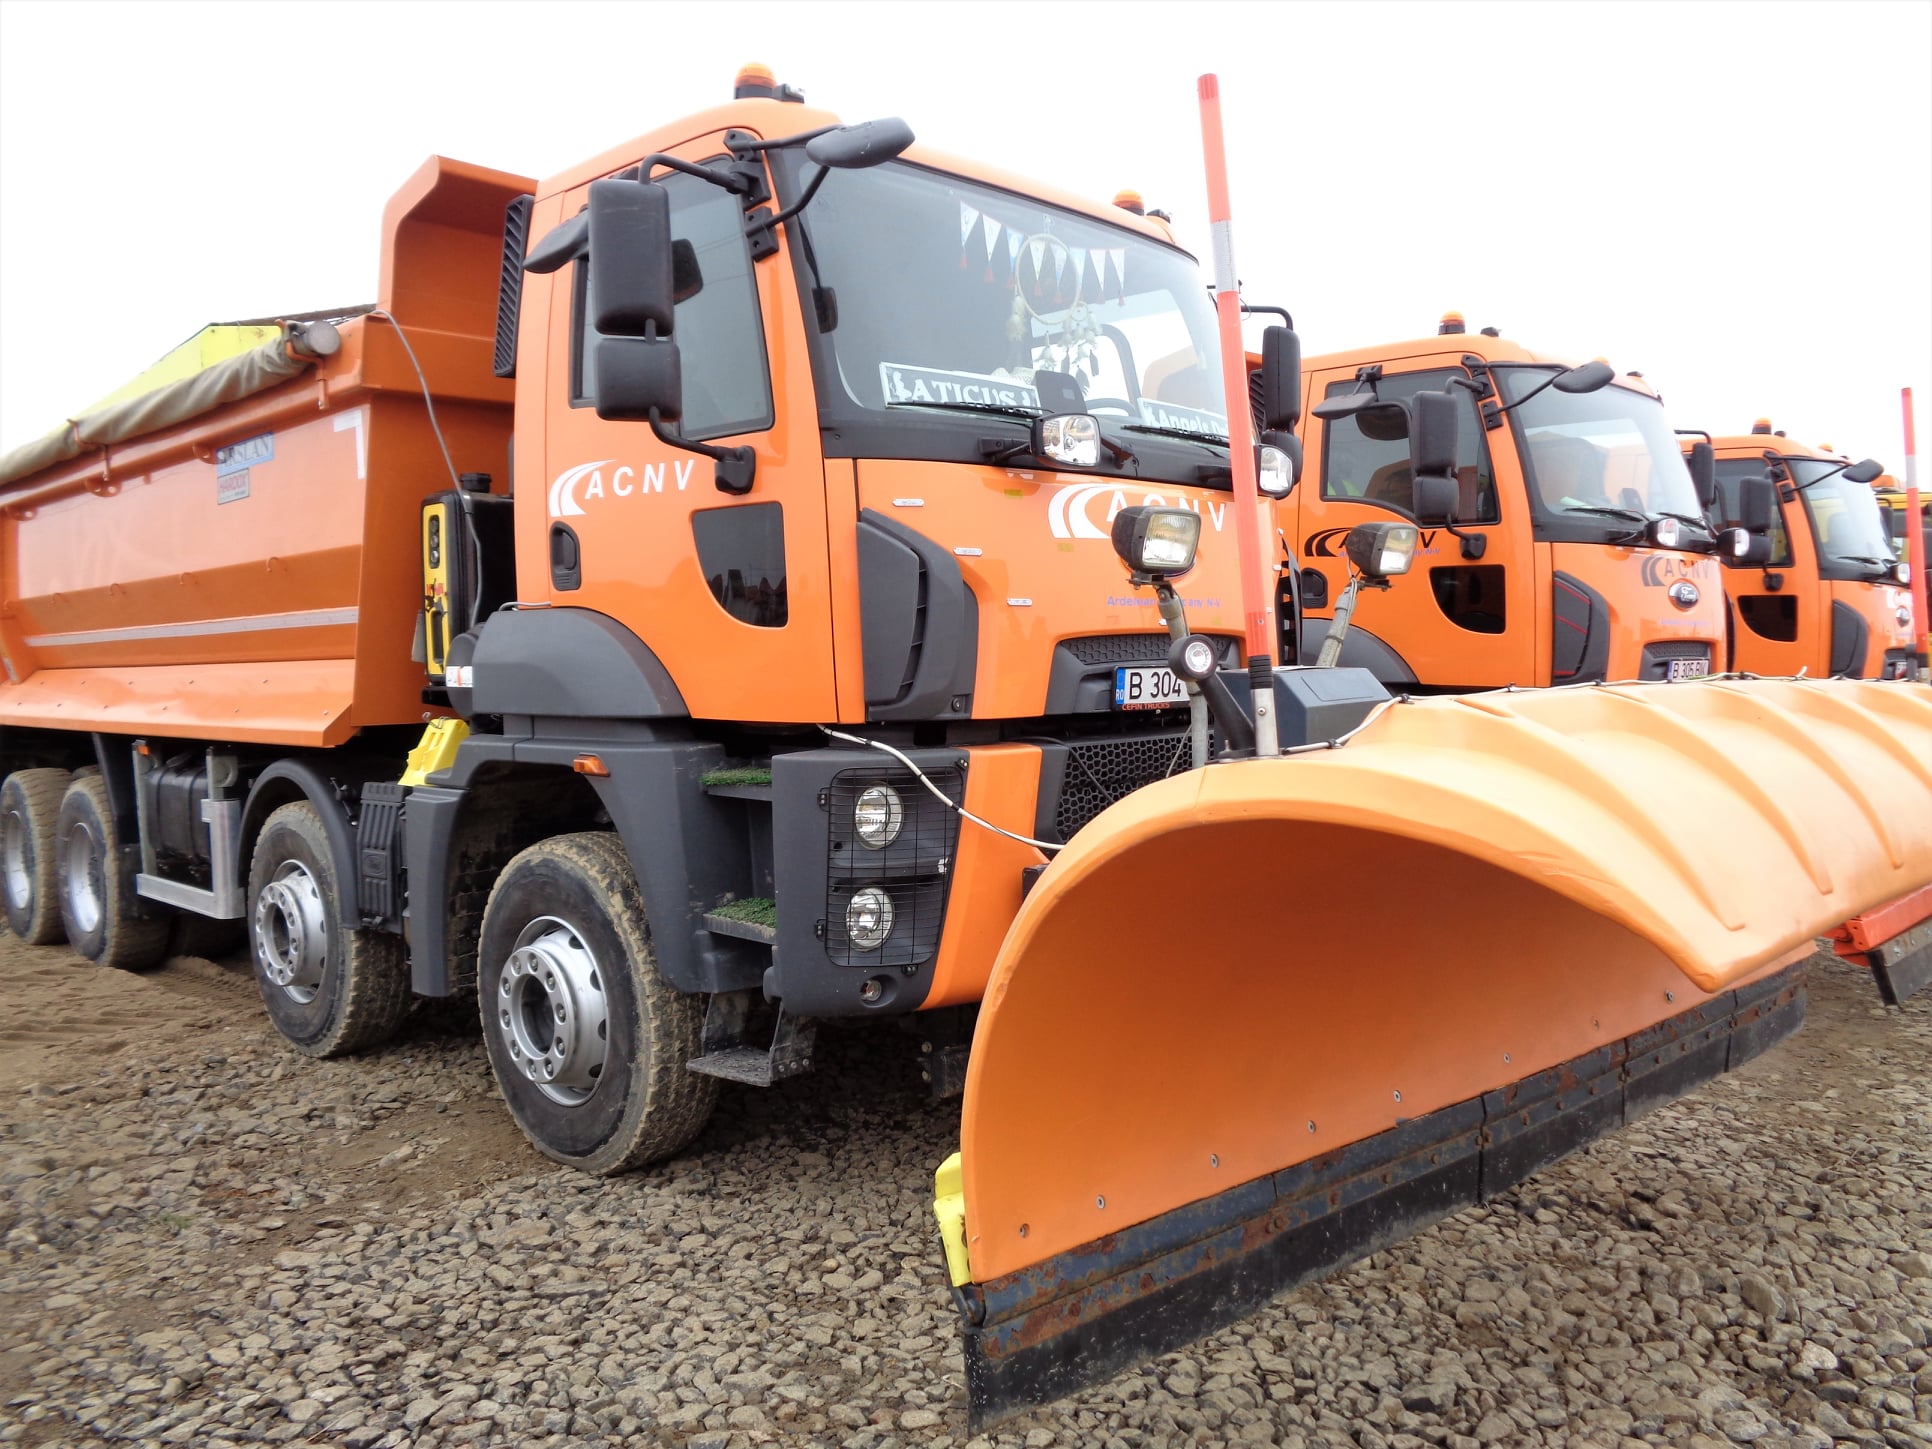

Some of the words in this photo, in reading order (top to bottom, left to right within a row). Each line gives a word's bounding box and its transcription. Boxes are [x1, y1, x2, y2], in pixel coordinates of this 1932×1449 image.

[584, 459, 695, 499] ACNV
[1129, 672, 1143, 700] B
[1150, 671, 1182, 698] 304
